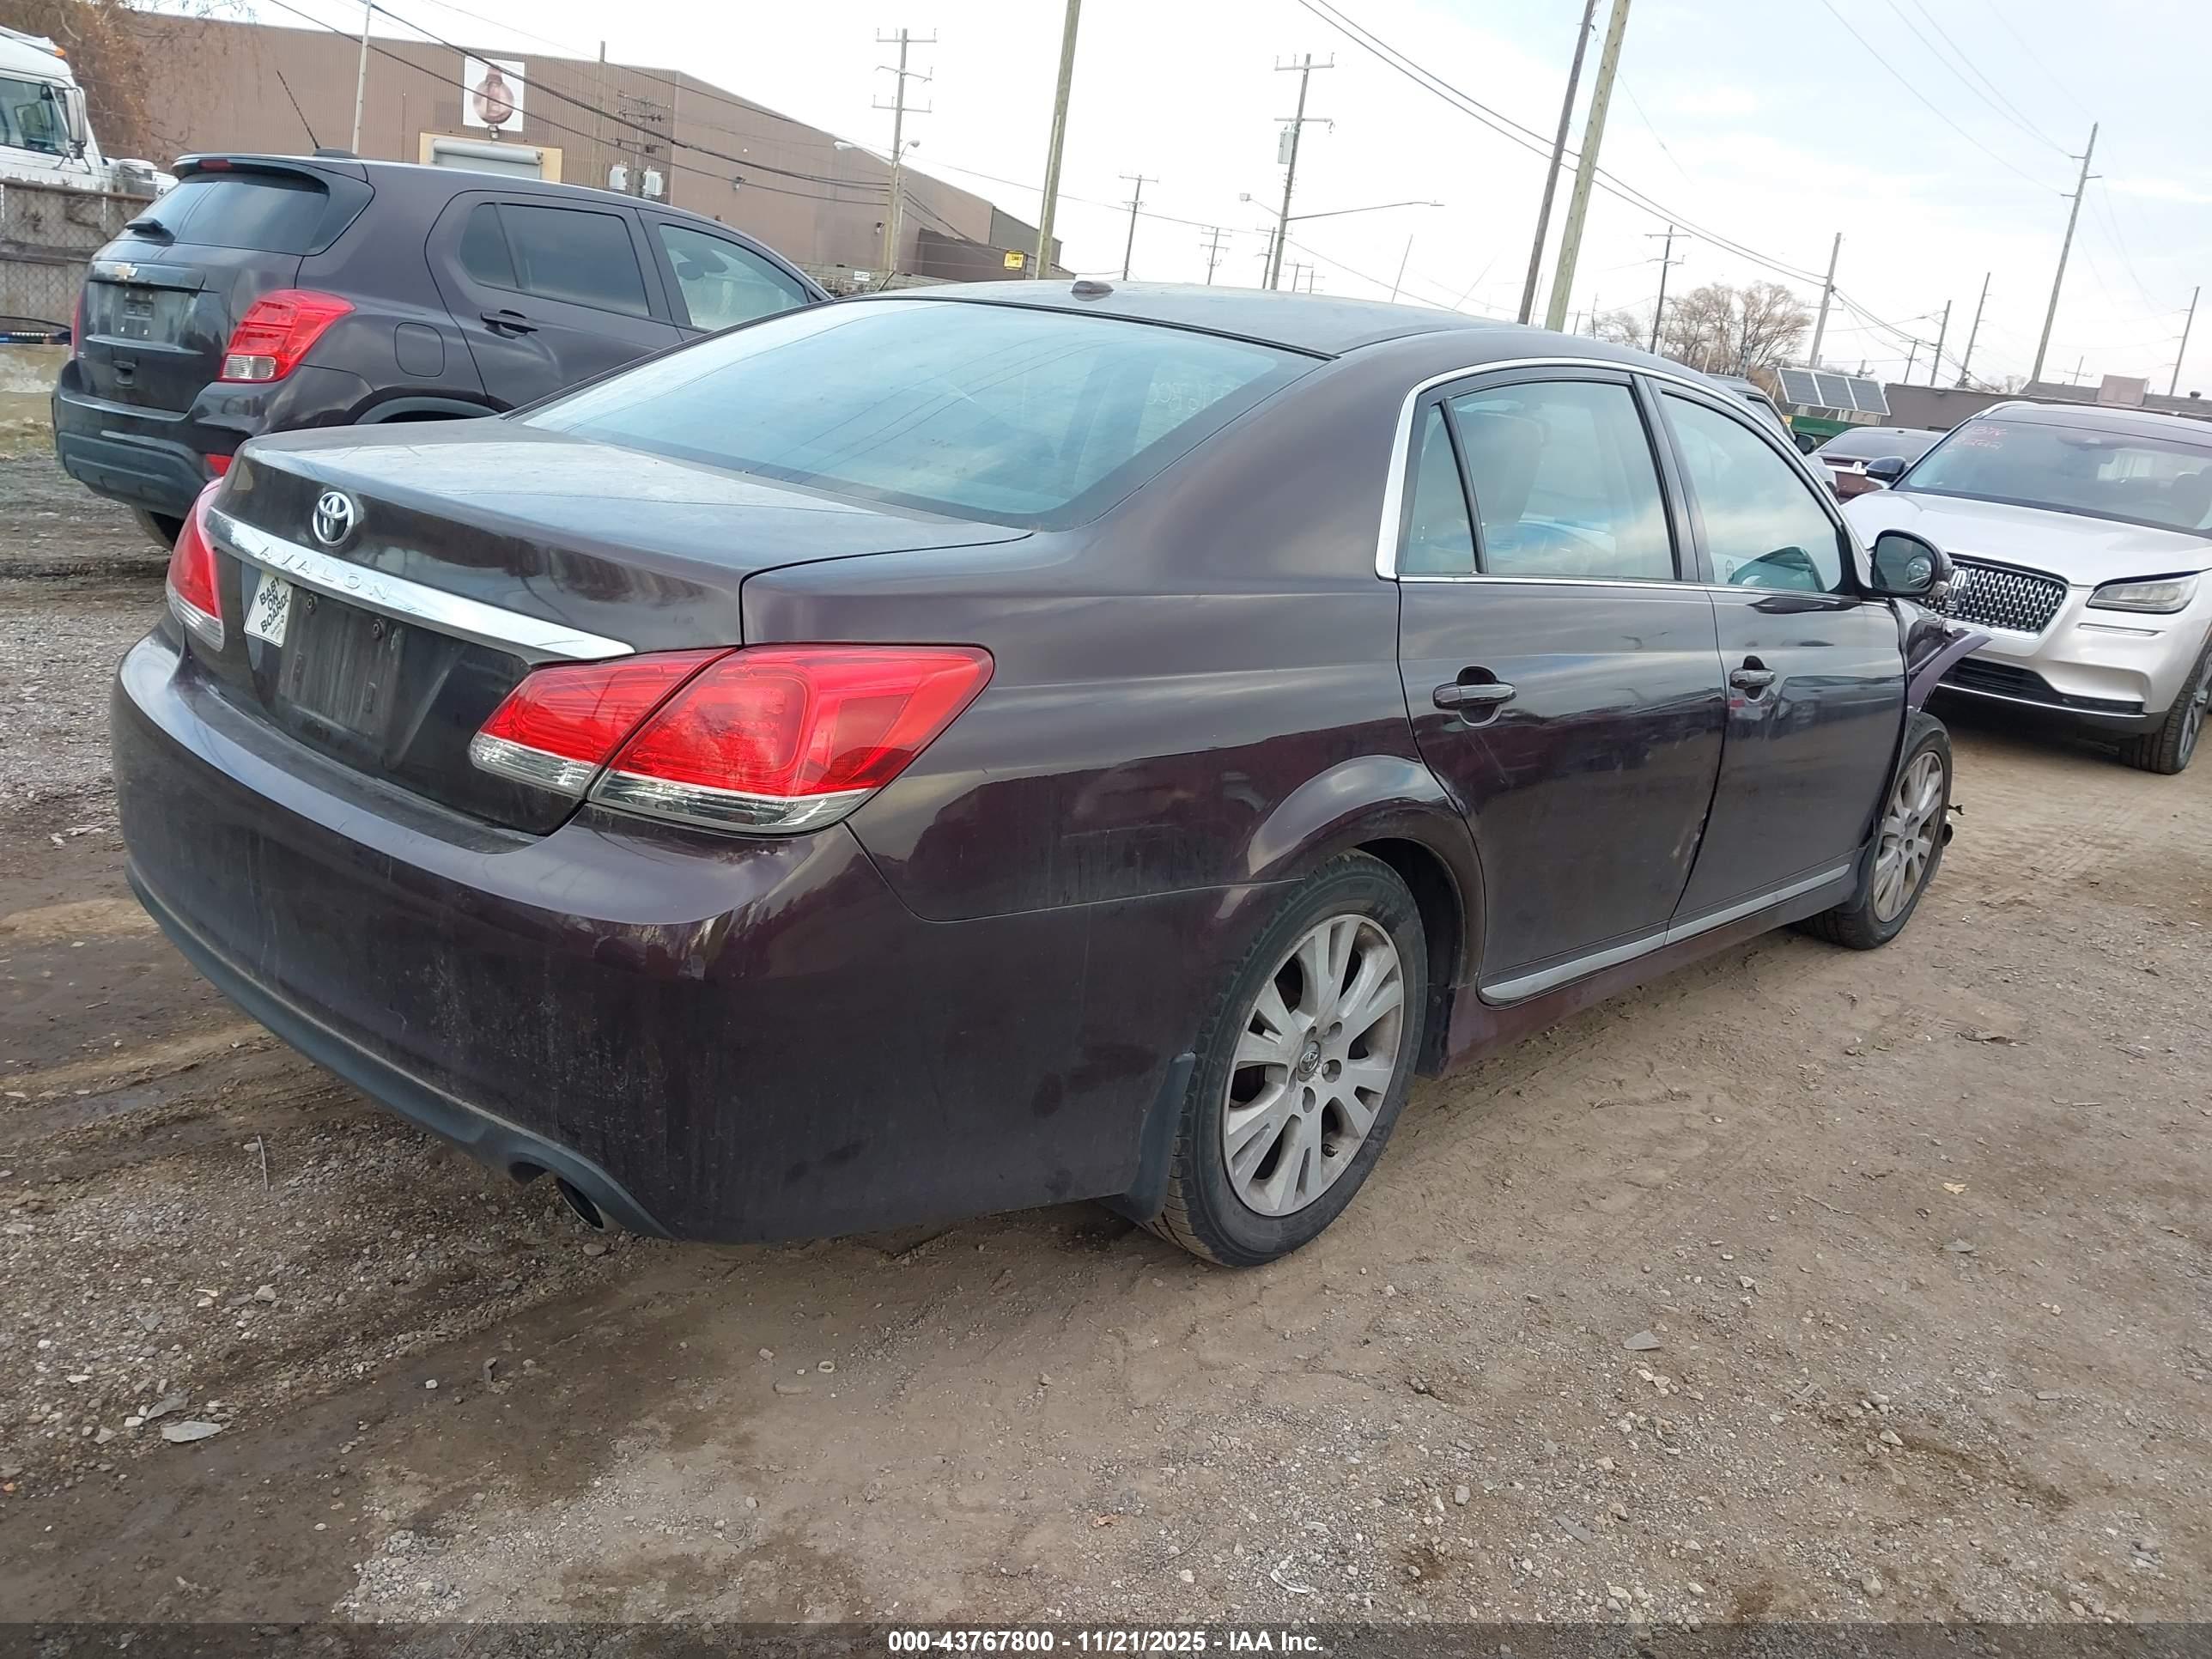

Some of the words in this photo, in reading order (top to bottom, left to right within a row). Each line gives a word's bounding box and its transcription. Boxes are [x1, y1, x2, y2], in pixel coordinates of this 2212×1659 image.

[260, 545, 391, 599] AVALON
[259, 577, 280, 606] BABY
[267, 590, 279, 611] ON
